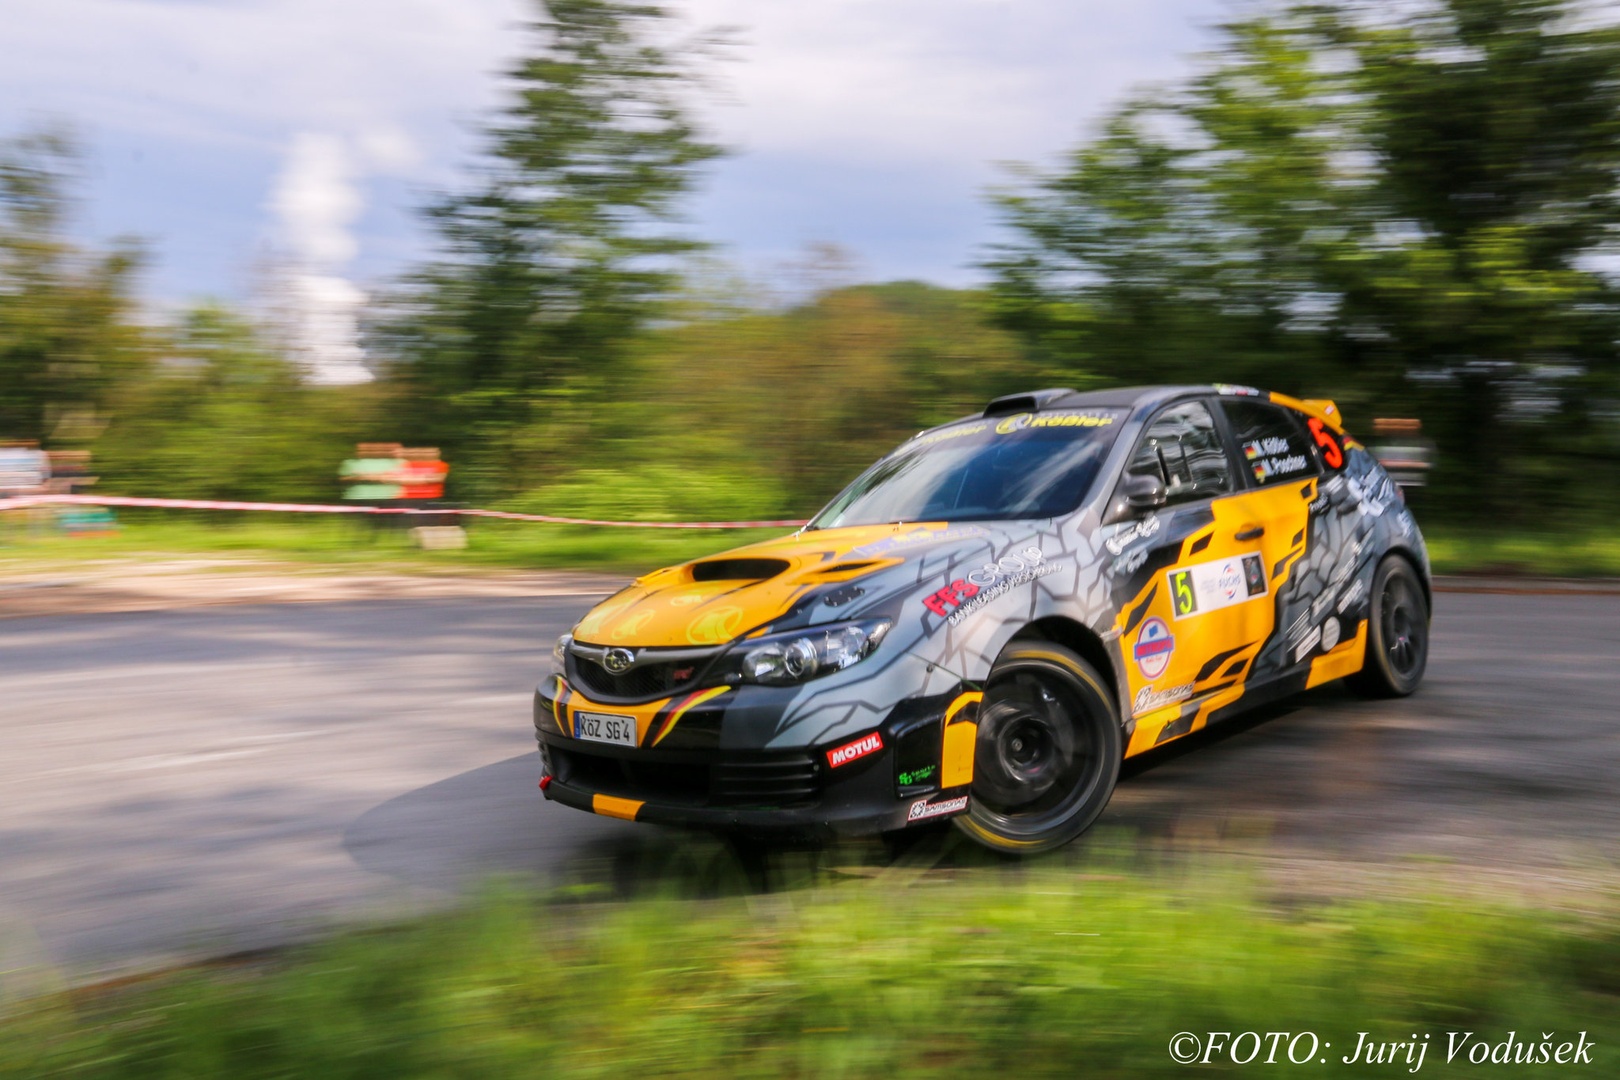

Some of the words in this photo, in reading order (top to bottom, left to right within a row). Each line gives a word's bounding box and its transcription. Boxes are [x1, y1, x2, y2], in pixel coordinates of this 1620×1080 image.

[1307, 417, 1343, 469] 5
[923, 578, 980, 617] FFS
[1175, 571, 1193, 614] 5
[831, 735, 881, 765] MOTUL
